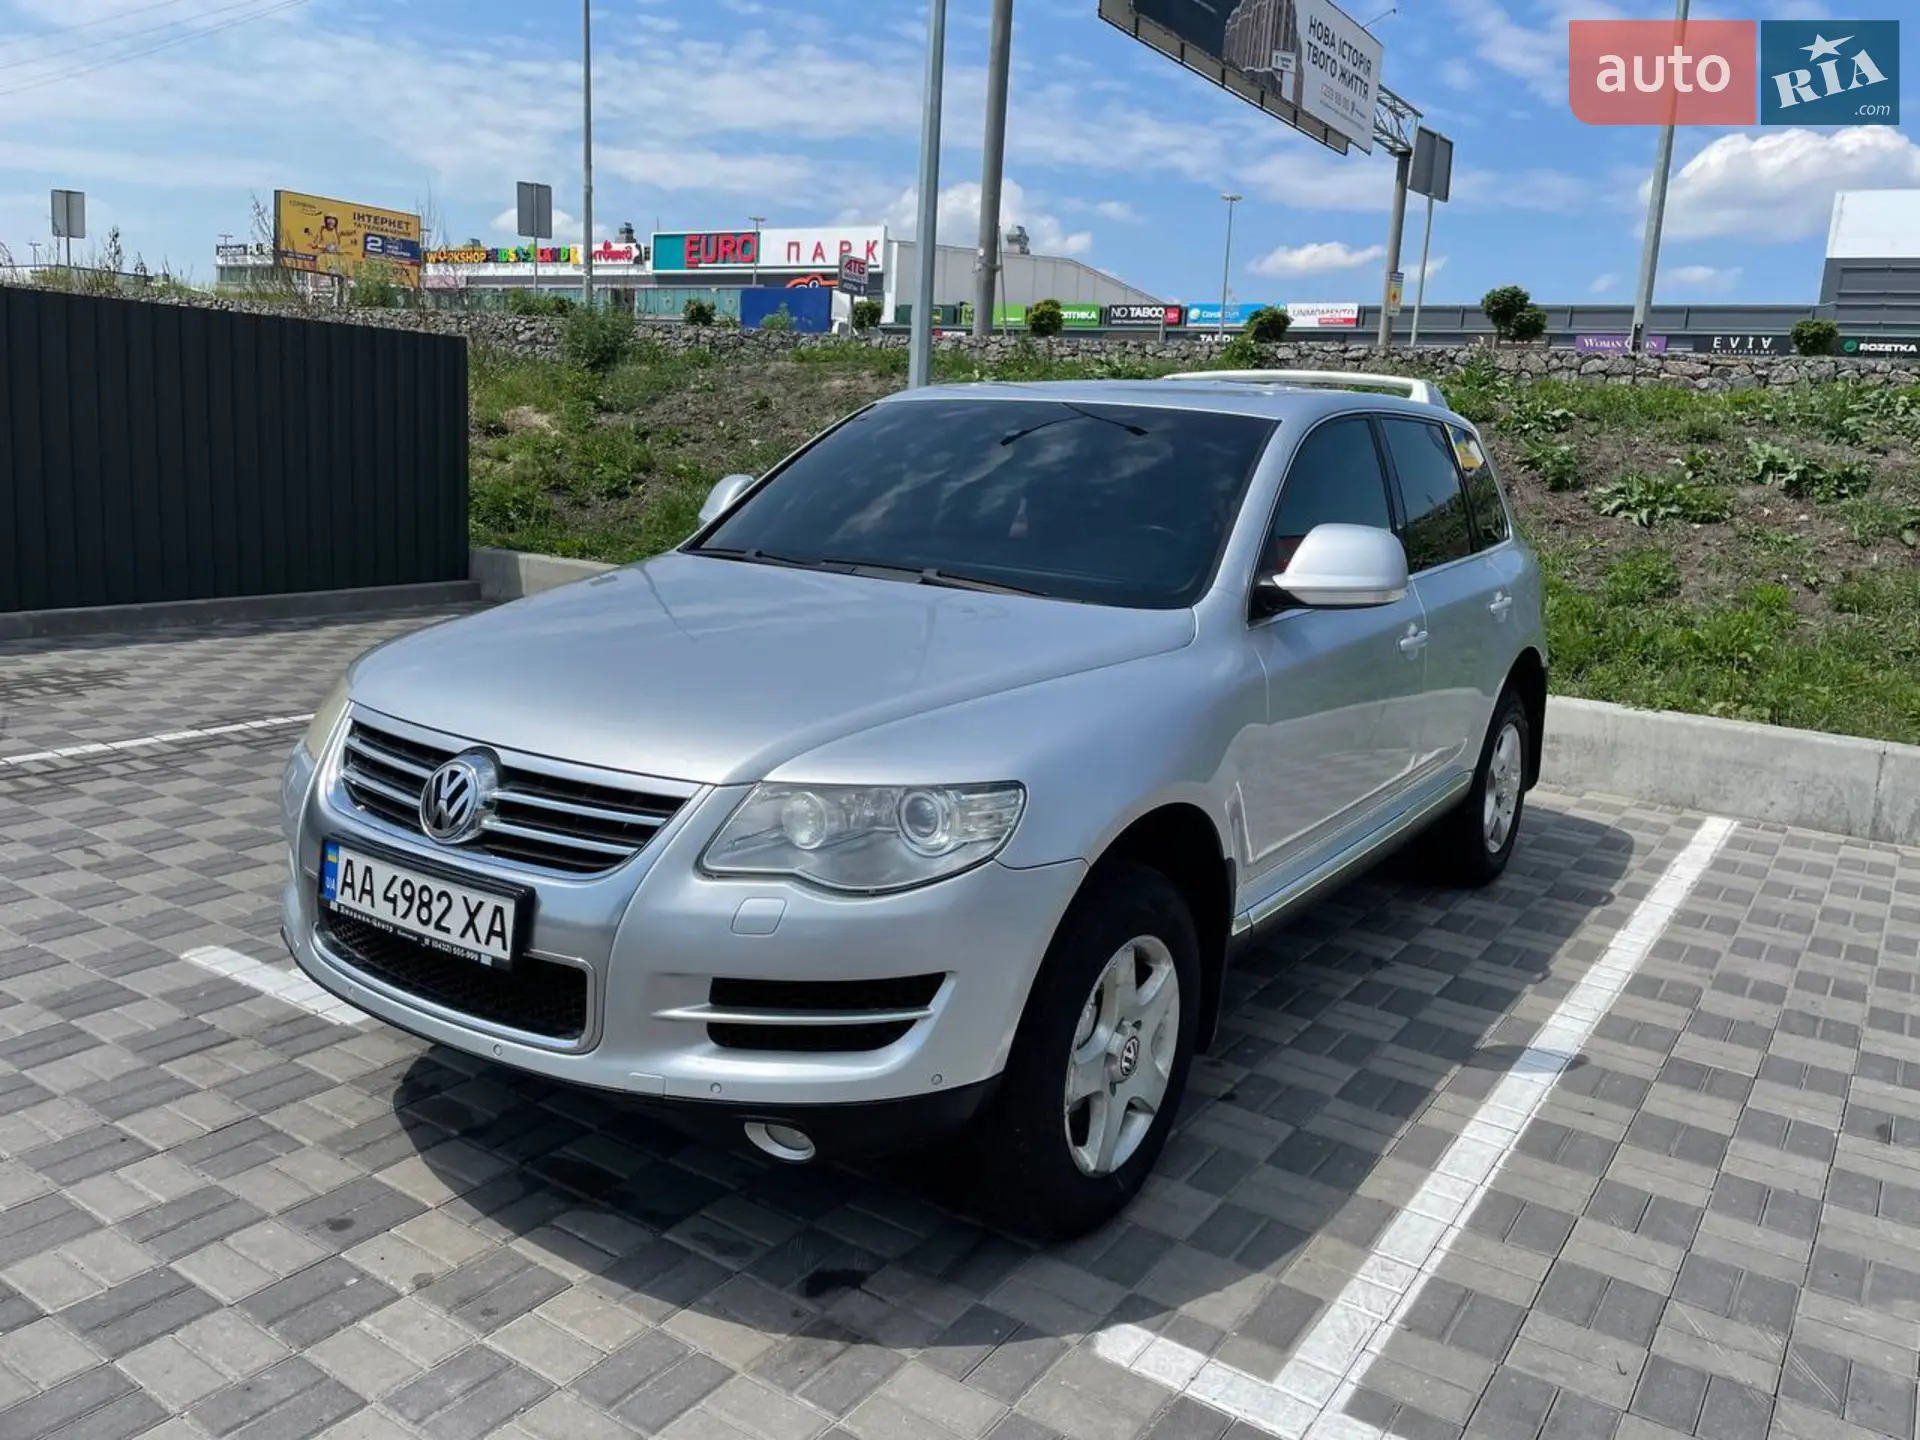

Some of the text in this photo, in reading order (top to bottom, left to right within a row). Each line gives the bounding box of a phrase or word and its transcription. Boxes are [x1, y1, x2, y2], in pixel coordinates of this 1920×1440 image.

[1308, 15, 1372, 78] НОВА ІСТОРІЯ
[1307, 40, 1338, 78] ТВОГО
[1338, 64, 1369, 101] ЖИТТЯ
[352, 211, 412, 231] ІНТЕРНЕТ
[366, 236, 383, 253] 2
[684, 233, 757, 269] EURO
[786, 239, 879, 264] ПАРК
[1110, 307, 1165, 318] NO TABOO
[1860, 343, 1917, 352] ROZETKA
[340, 858, 376, 909] AA
[383, 874, 453, 934] 4982
[459, 894, 509, 952] XA
